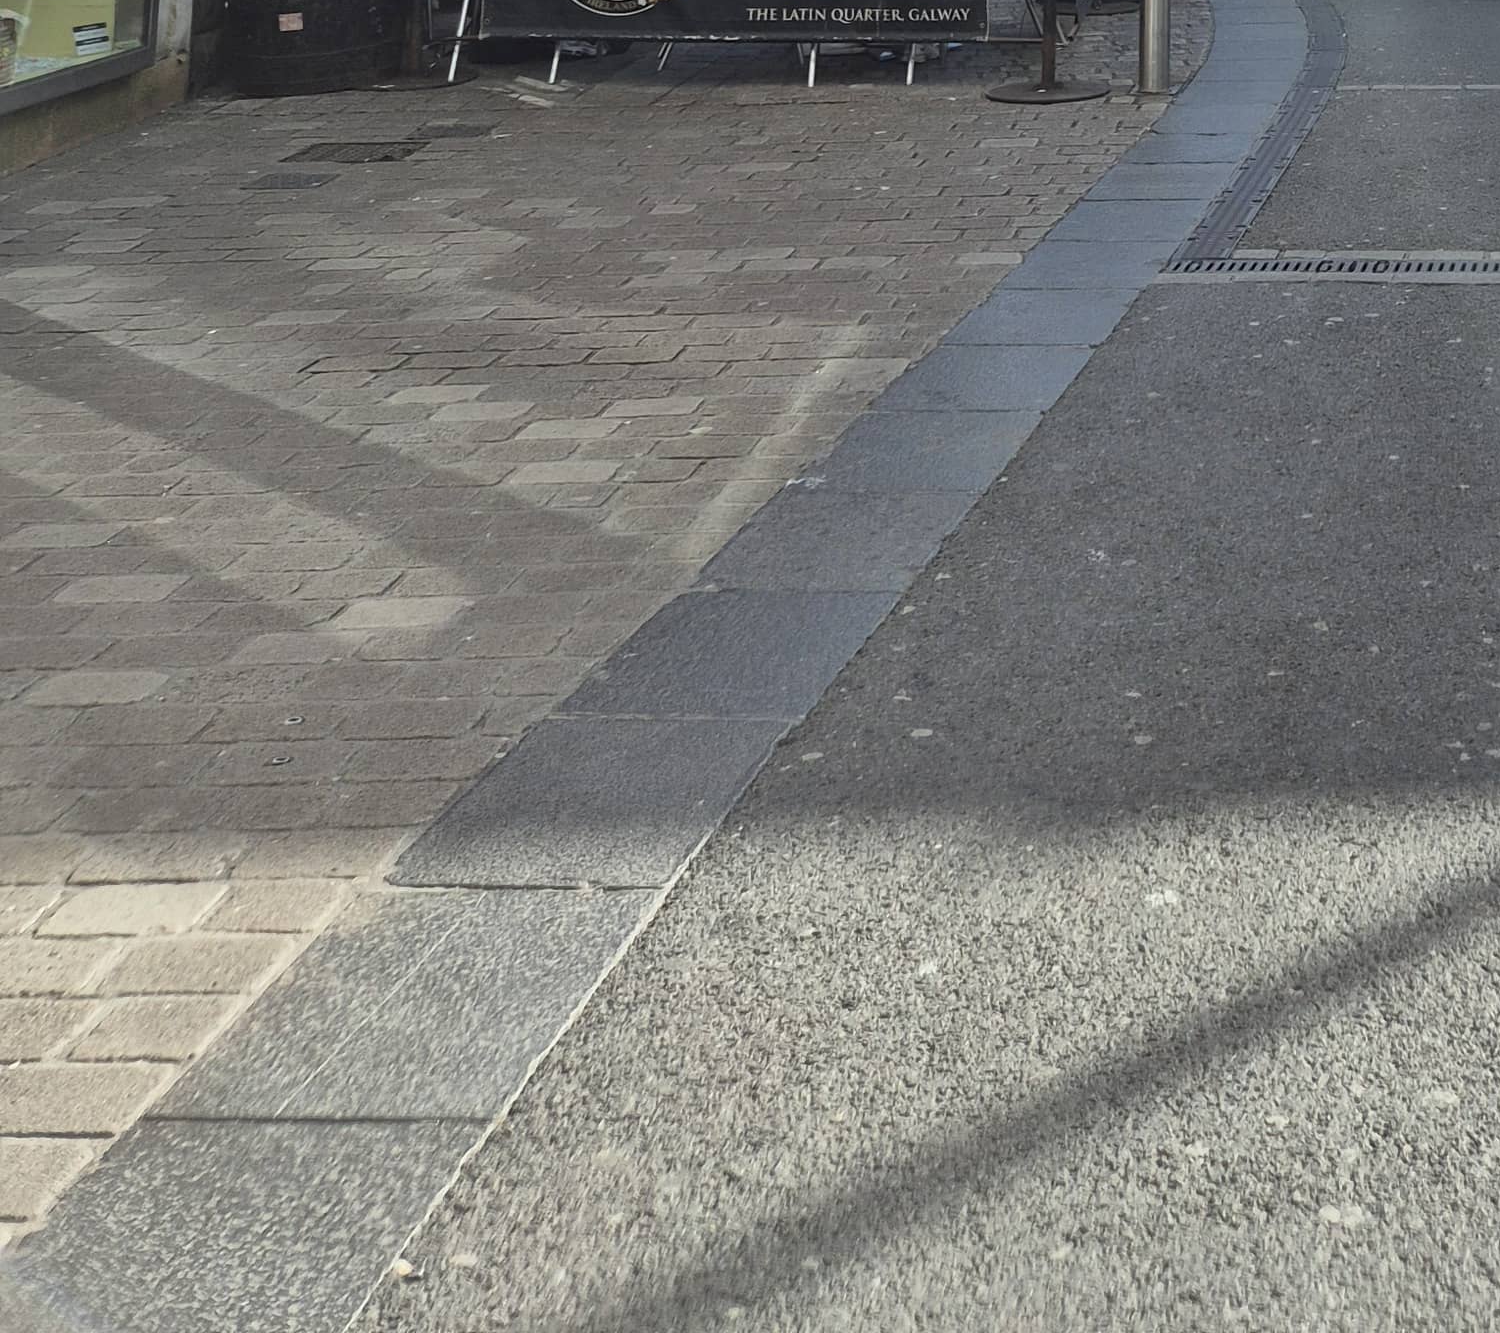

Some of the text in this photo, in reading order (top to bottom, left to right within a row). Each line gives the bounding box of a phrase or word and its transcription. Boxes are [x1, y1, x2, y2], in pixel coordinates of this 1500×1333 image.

[746, 8, 777, 22] THE
[782, 7, 827, 22] LATIN
[908, 7, 971, 22] GALWAY
